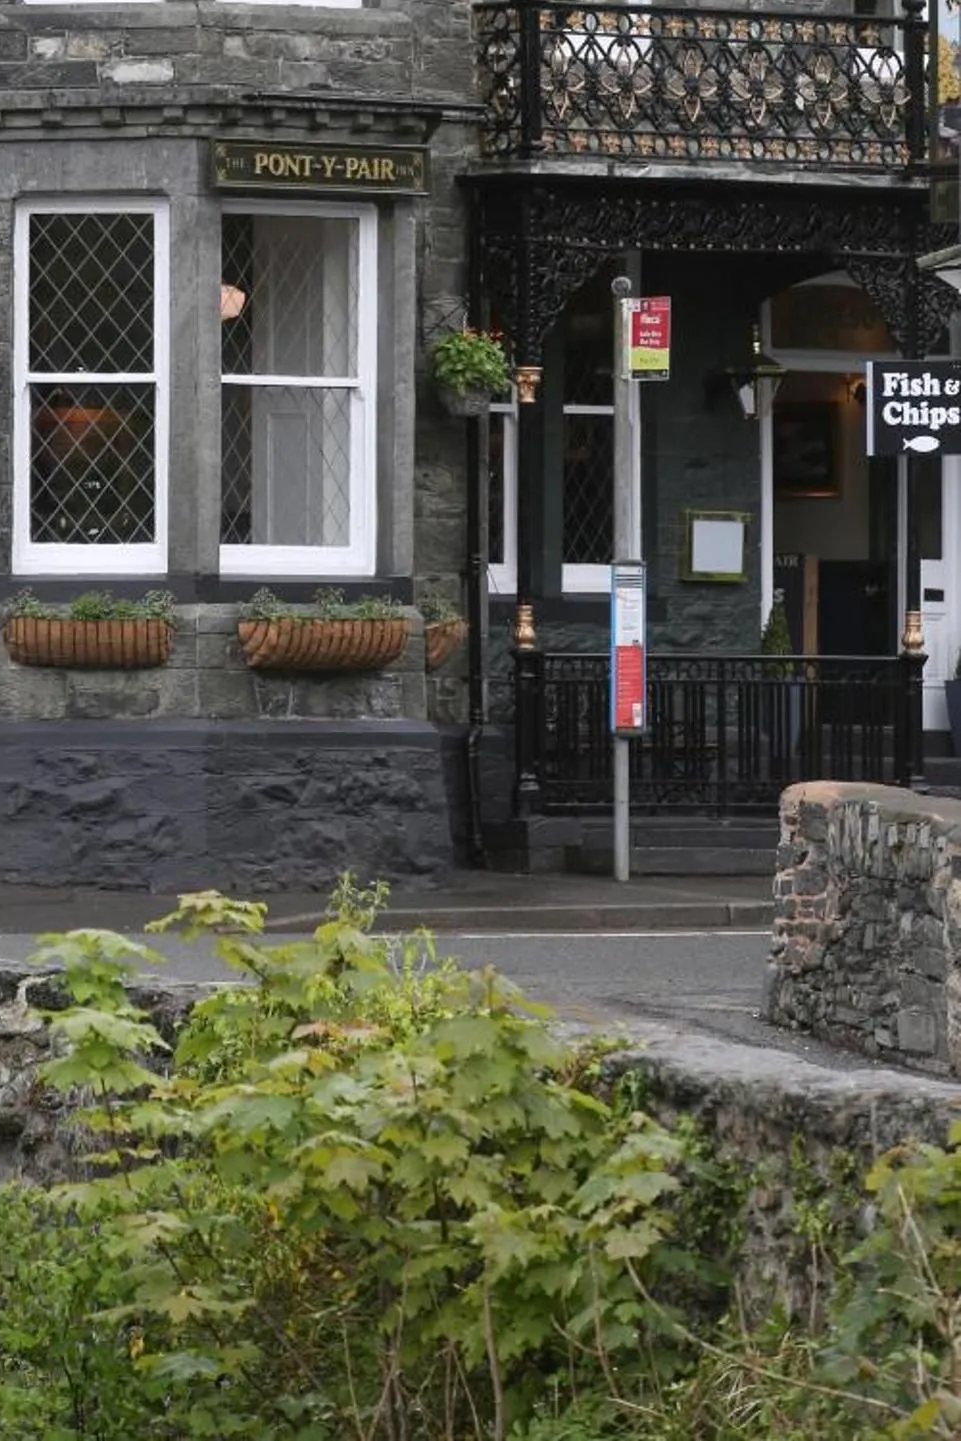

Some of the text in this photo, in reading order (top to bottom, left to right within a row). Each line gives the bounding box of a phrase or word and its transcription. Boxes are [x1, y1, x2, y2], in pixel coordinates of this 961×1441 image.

[254, 152, 396, 181] PONT-Y-PAIR
[882, 372, 961, 397] Fish &
[882, 401, 961, 431] Chips
